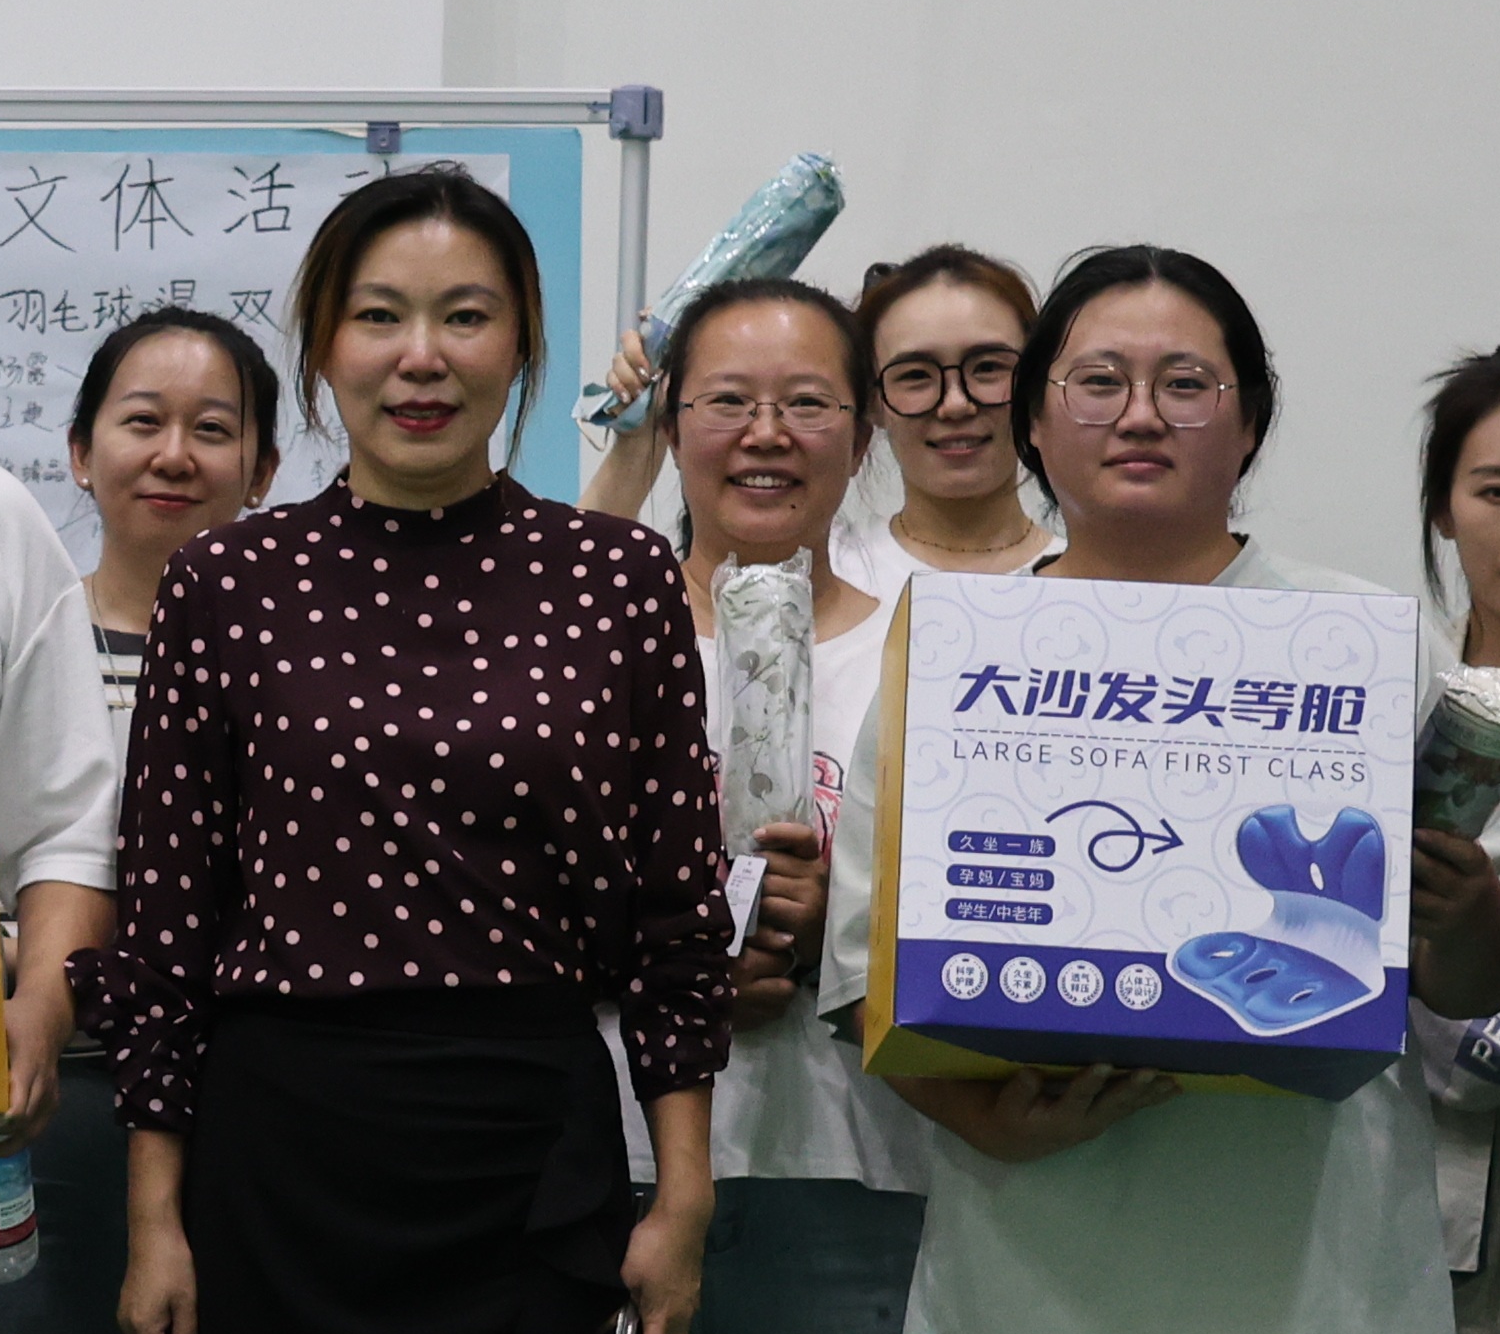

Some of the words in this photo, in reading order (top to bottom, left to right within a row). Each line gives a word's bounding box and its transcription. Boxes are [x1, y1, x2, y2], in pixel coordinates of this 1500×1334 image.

[954, 664, 1366, 736] 大沙发头等舱
[954, 740, 1053, 766] LARGE
[1070, 745, 1149, 771] SOFA
[1165, 750, 1252, 777] FIRST
[1268, 756, 1366, 783] CLASS
[960, 834, 1045, 854] 久坐一族
[959, 868, 1044, 888] 孕妈/宝妈
[958, 902, 1042, 922] 学生/中老年
